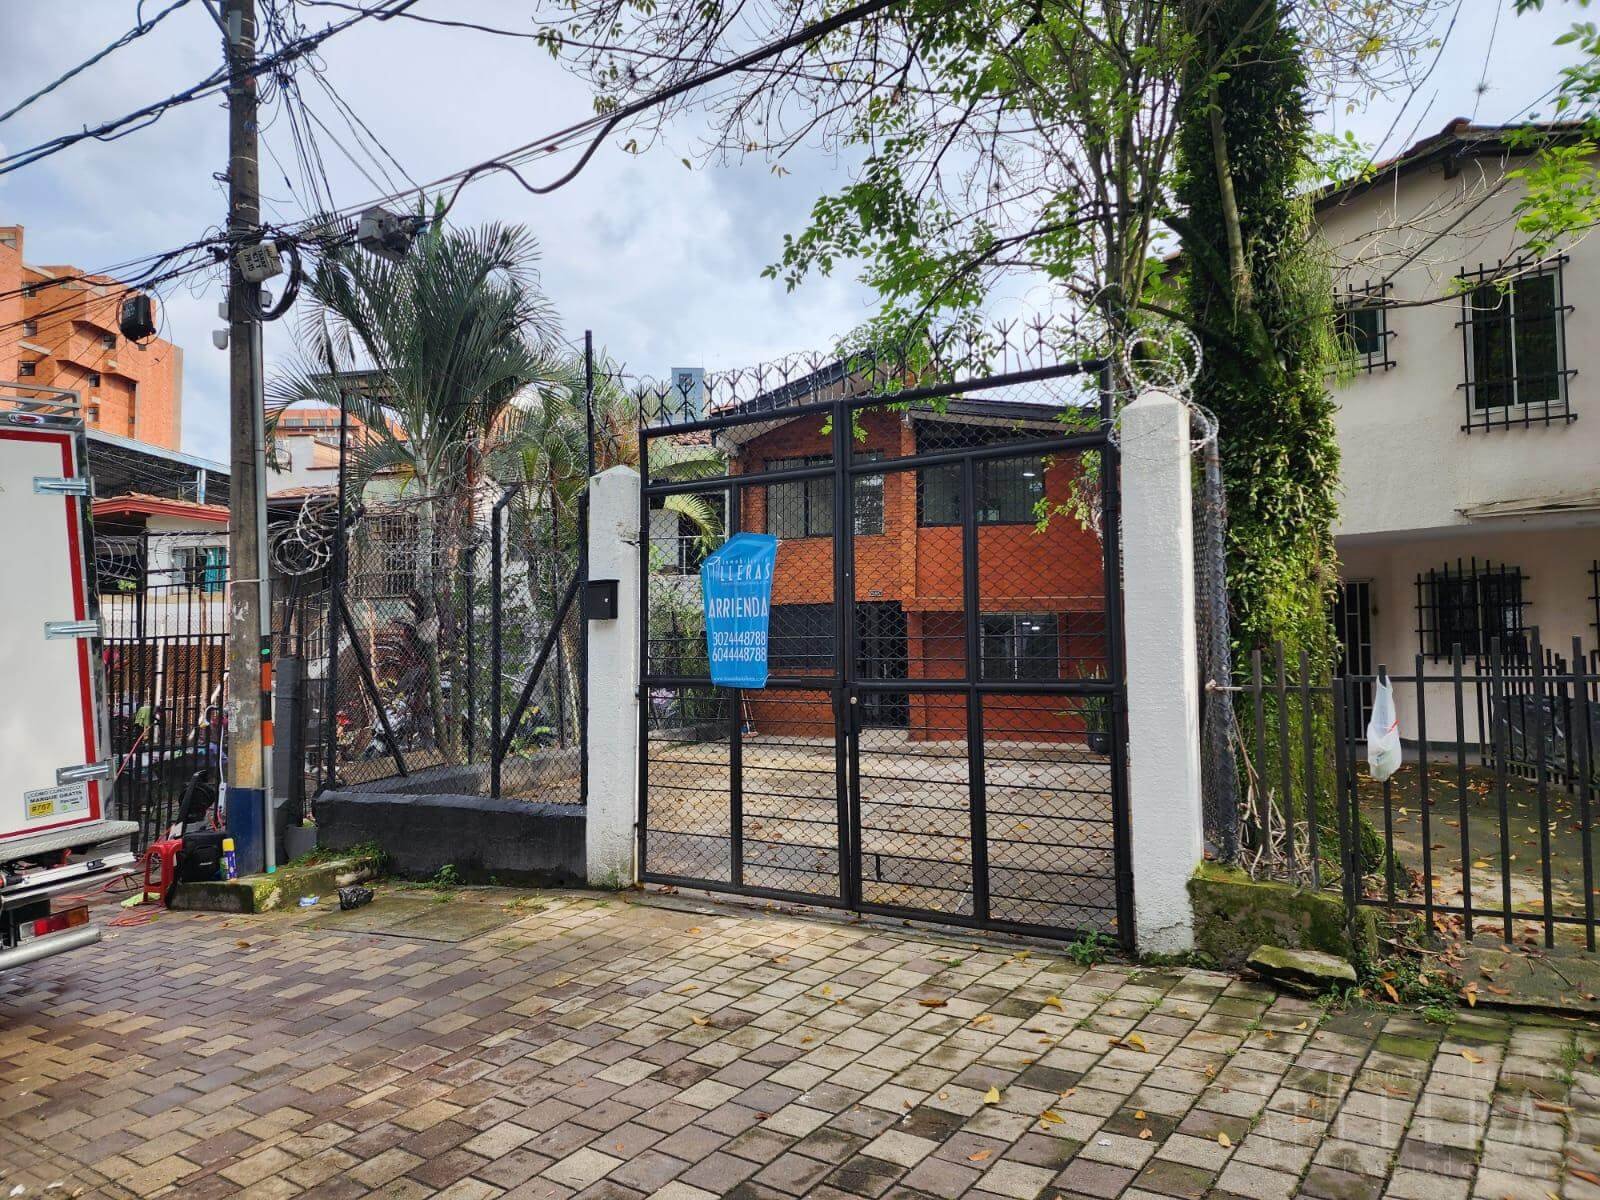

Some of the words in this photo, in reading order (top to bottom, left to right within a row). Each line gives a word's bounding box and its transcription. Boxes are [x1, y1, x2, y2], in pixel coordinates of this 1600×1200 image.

[708, 596, 769, 618] ARRIENDA
[712, 631, 766, 646] 3024448788
[712, 647, 767, 662] 6044448788
